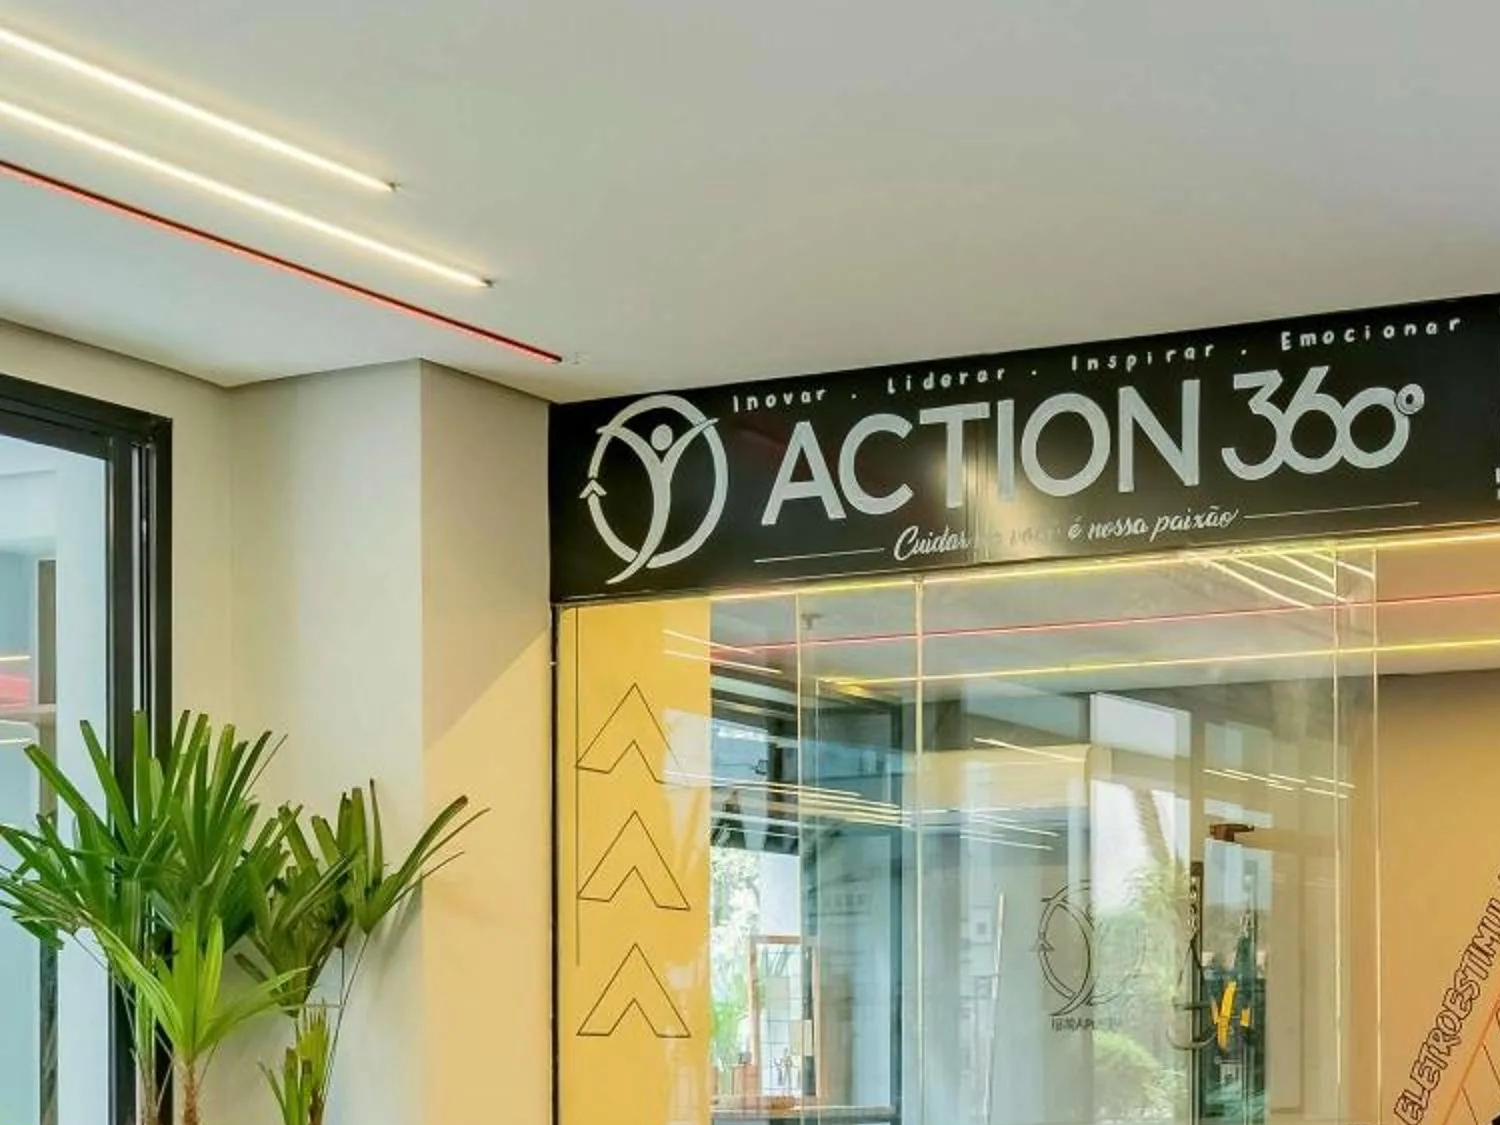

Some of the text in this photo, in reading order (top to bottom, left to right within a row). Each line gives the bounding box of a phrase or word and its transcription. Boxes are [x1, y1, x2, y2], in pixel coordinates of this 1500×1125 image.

[732, 317, 1462, 413] Inovar Liderar Inspirar Emocionar
[760, 378, 1201, 527] ACTION
[1086, 516, 1150, 541] nossa
[1149, 504, 1239, 543] paixão
